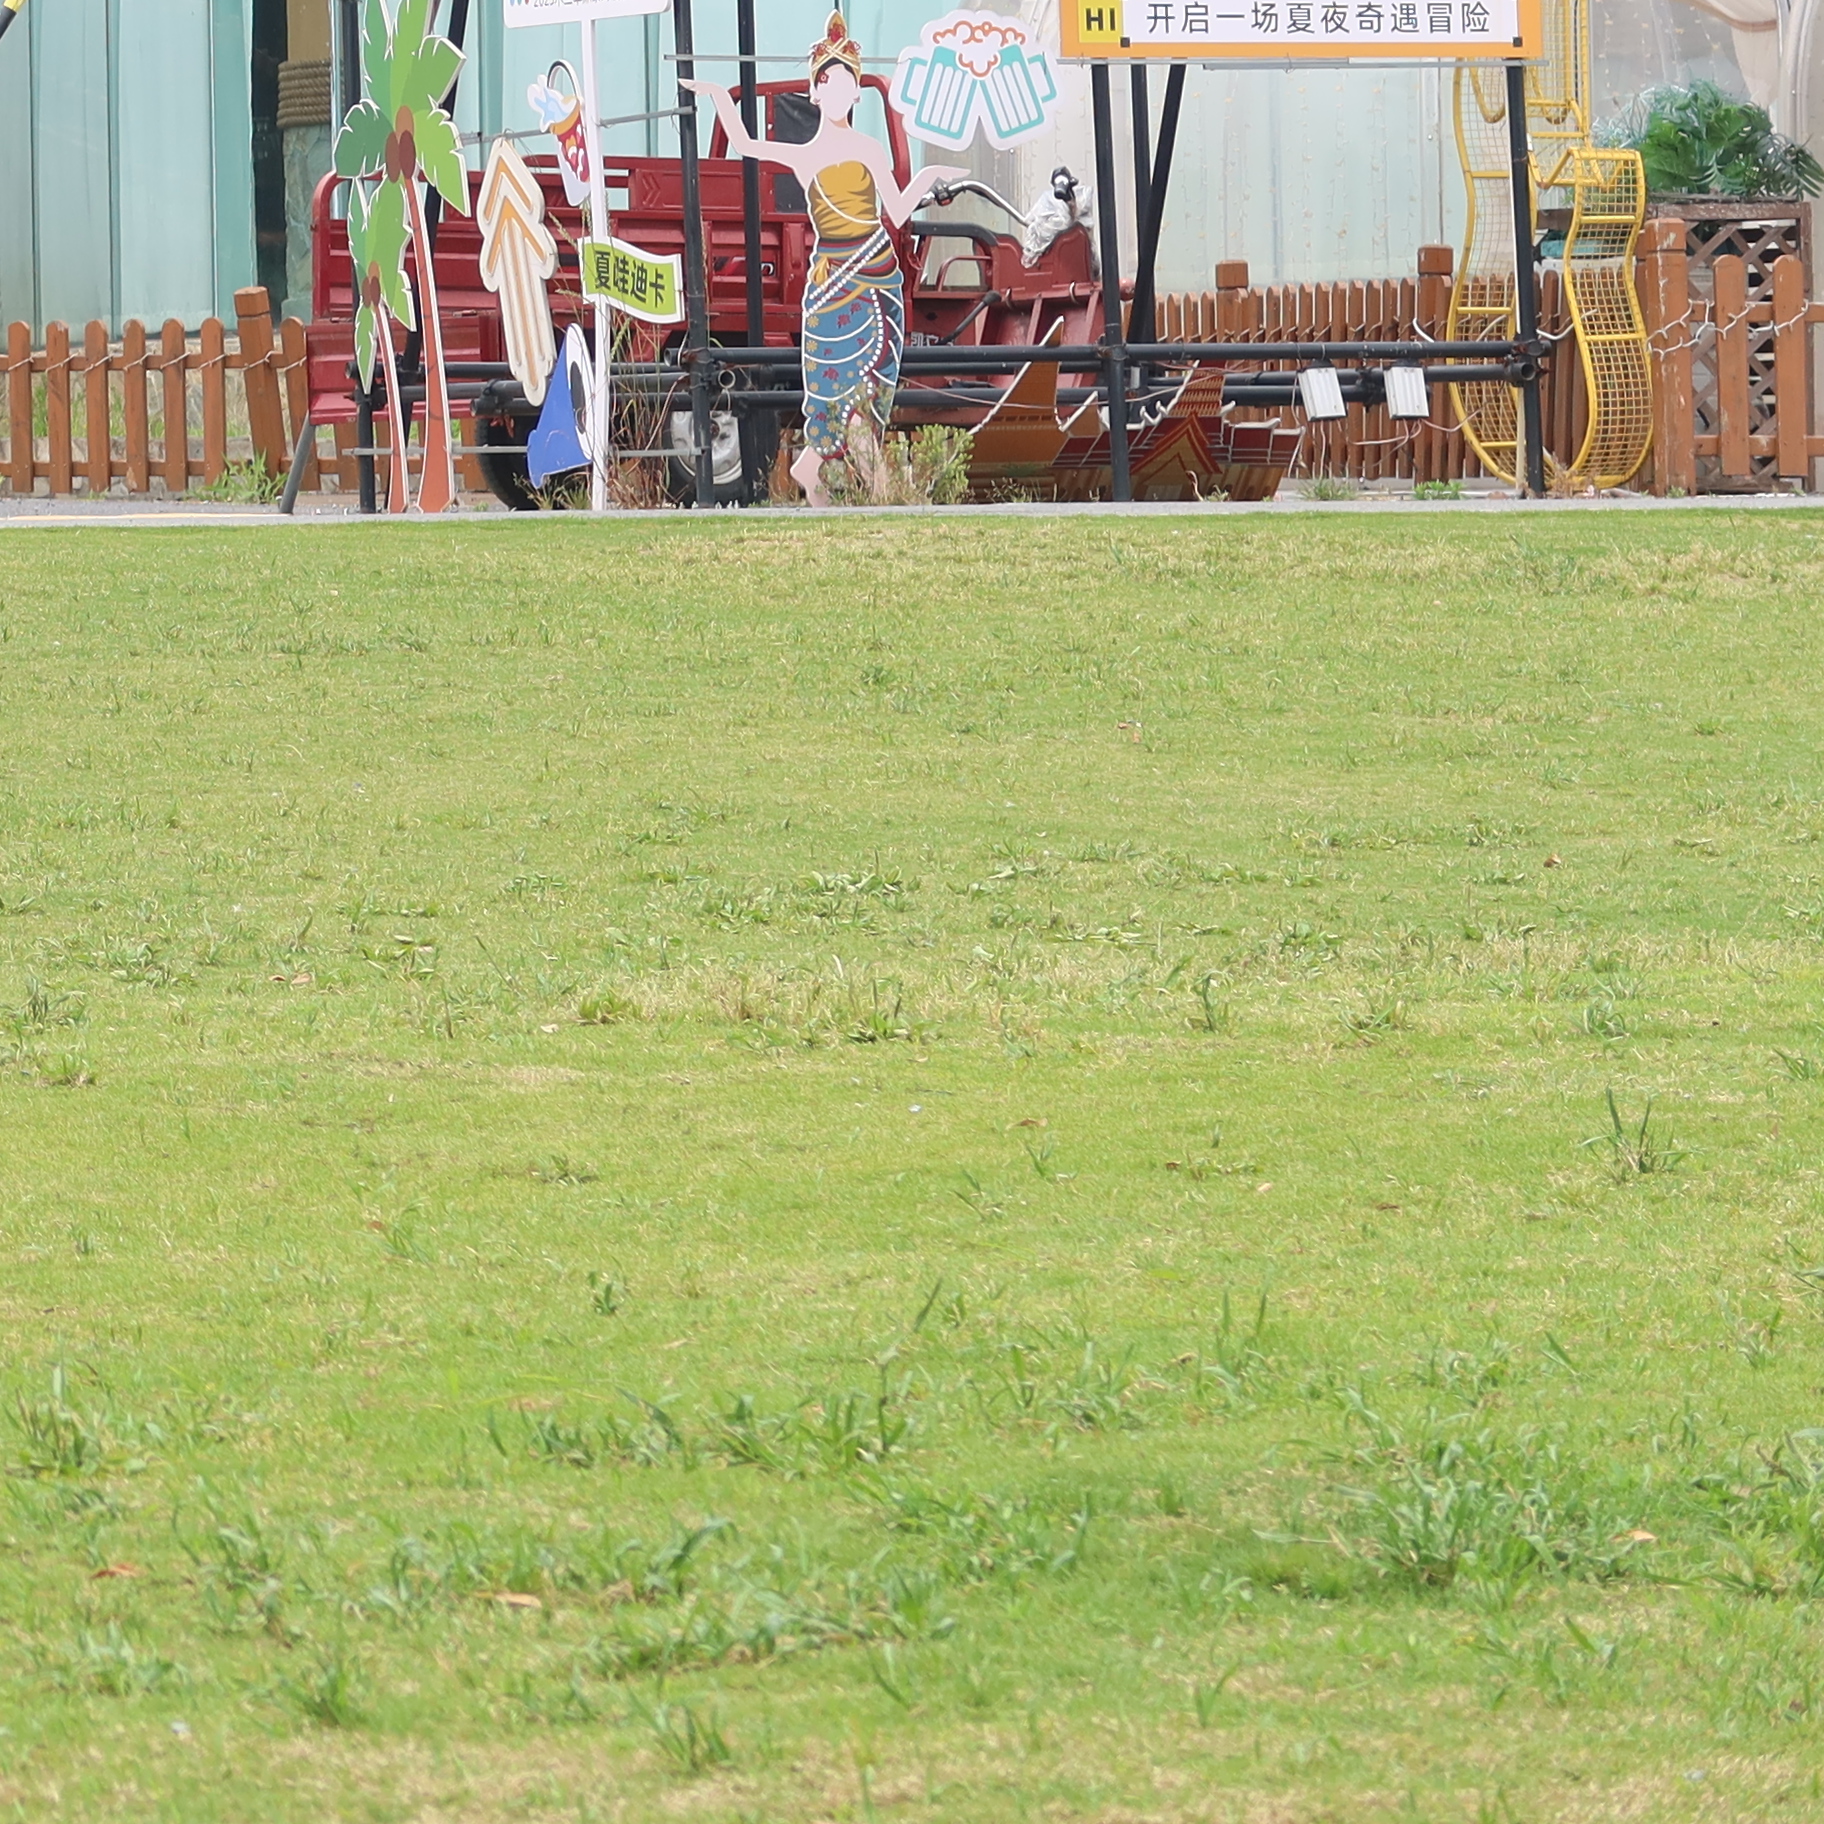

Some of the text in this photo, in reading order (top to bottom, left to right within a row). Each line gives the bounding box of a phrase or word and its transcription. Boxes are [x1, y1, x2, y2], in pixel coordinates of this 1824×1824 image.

[1085, 1, 1490, 34] HI 开启一场夏夜奇遇冒险
[595, 251, 665, 308] 夏哇迪卡
